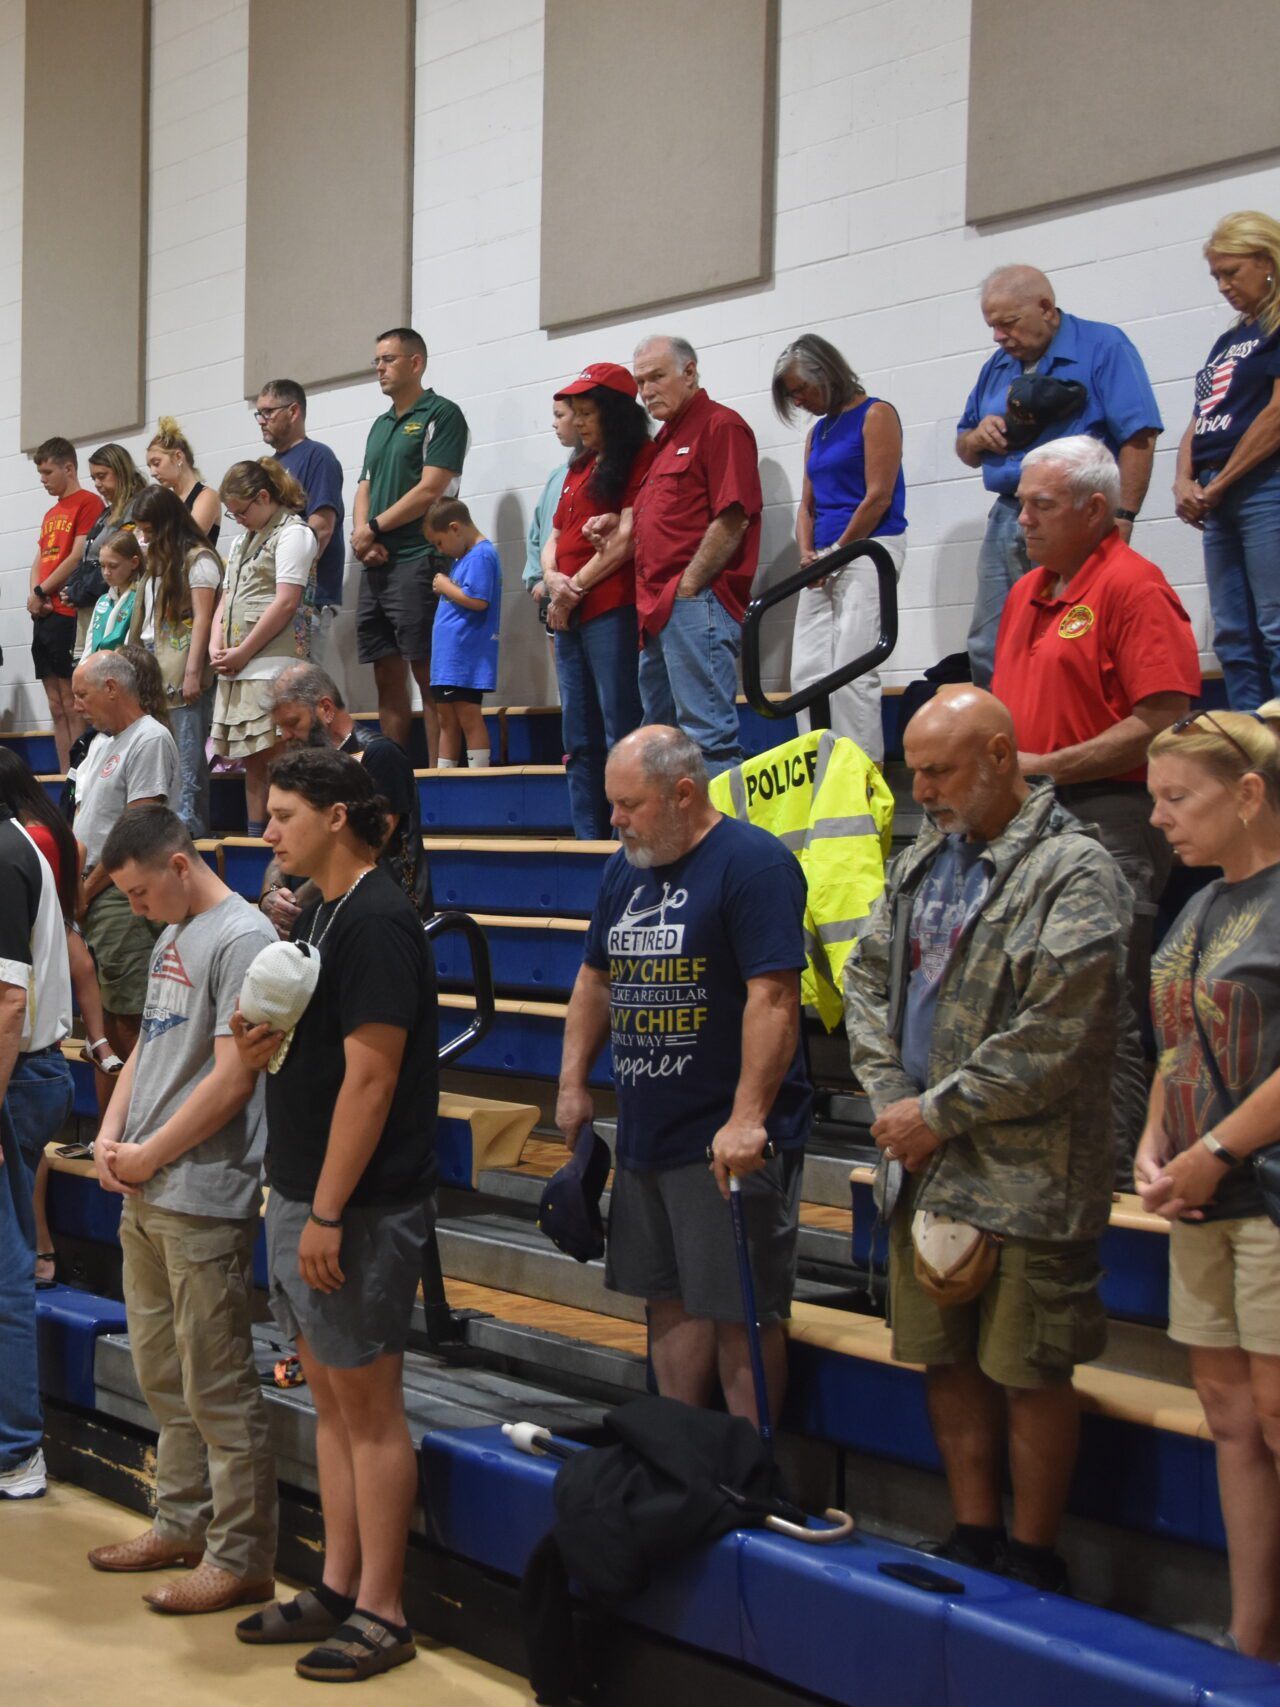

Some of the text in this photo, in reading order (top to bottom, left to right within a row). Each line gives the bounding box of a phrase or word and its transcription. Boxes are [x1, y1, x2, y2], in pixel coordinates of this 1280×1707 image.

[1195, 414, 1232, 434] erica
[746, 750, 817, 807] POLICE
[610, 928, 678, 952] RETIRED
[610, 957, 707, 983] AVY CHIEF
[640, 988, 708, 1003] REGULAR
[635, 1007, 707, 1033] CHIEF
[636, 1035, 663, 1047] WAY
[614, 1048, 693, 1087] appier
